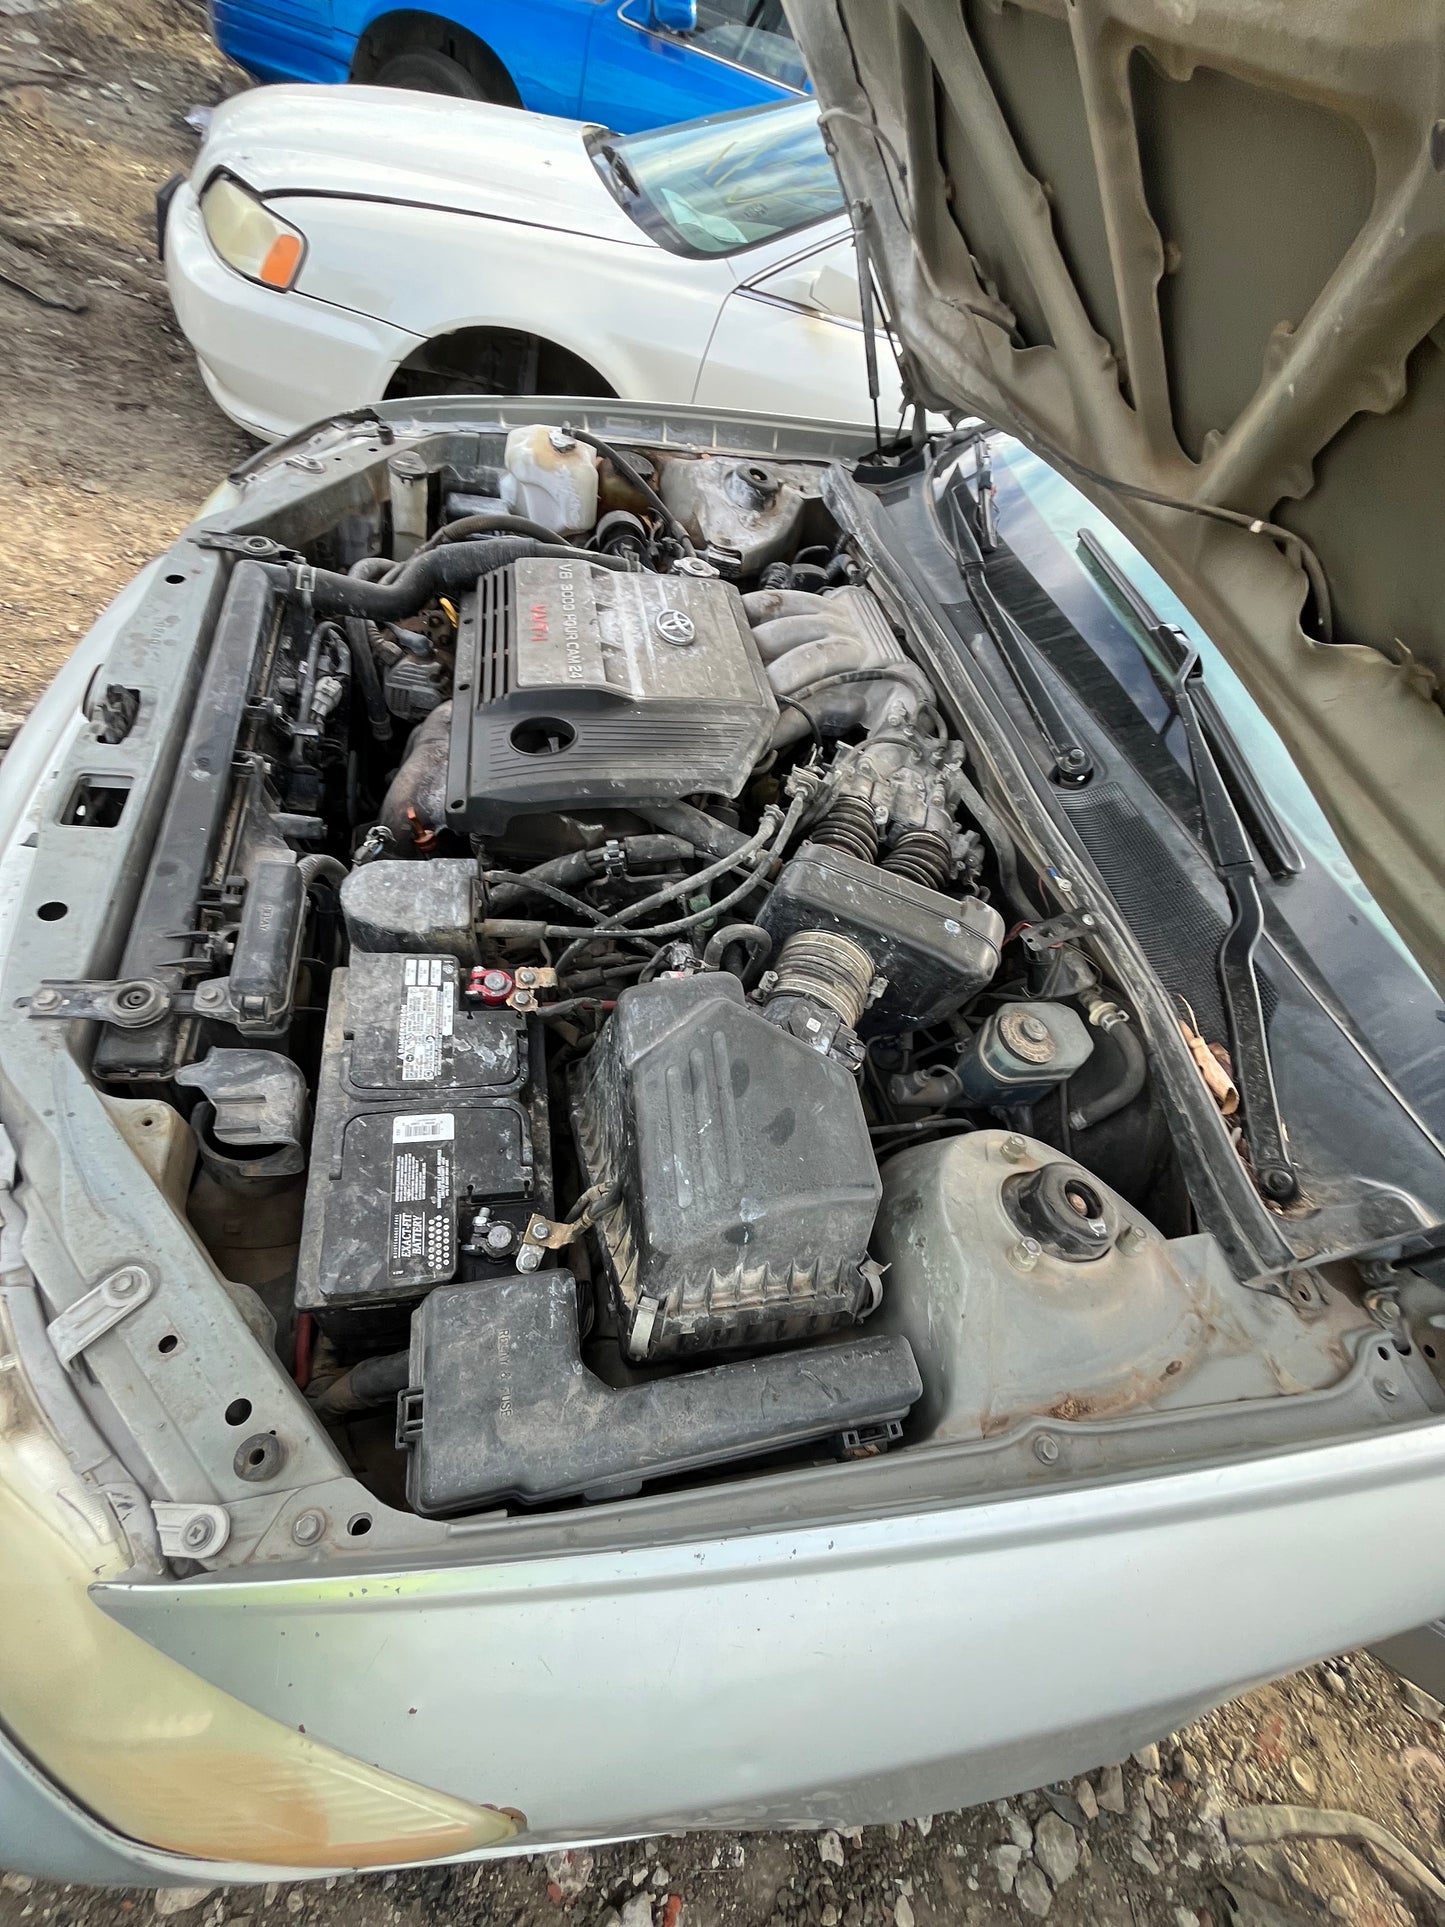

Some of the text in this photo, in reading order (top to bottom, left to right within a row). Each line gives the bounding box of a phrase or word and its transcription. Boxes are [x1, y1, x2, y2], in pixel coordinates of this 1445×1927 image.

[559, 564, 573, 579] V6
[561, 583, 575, 610] 3000
[566, 642, 582, 664] CAM
[568, 665, 582, 679] 24
[401, 1212, 412, 1258] EXACT-FIT
[412, 1214, 422, 1255] BATTERY
[498, 1329, 511, 1365] RELAY
[501, 1371, 511, 1380] &
